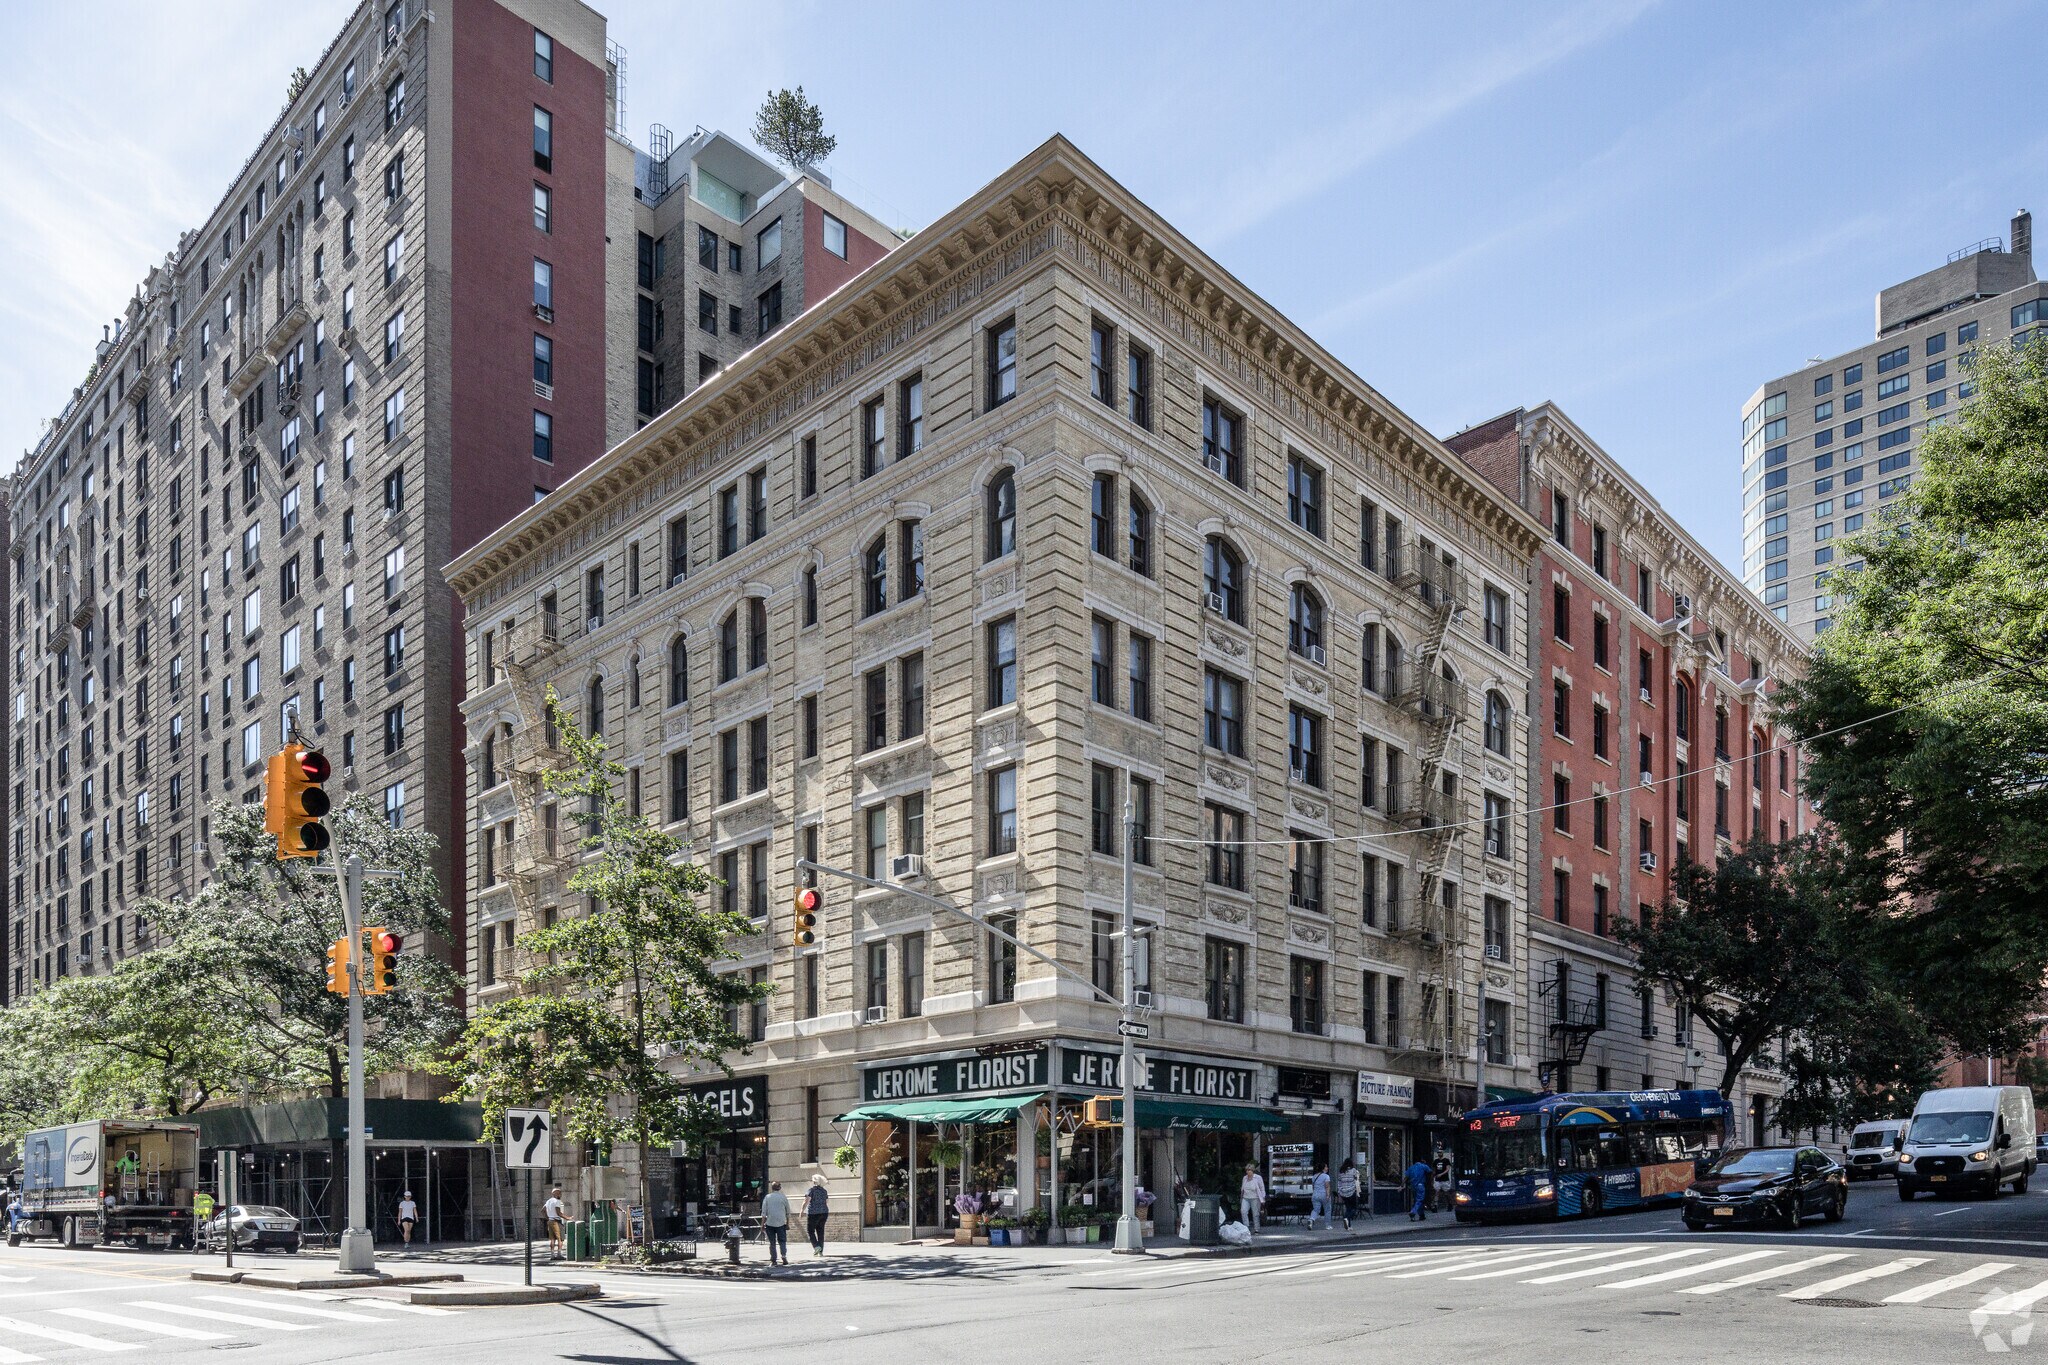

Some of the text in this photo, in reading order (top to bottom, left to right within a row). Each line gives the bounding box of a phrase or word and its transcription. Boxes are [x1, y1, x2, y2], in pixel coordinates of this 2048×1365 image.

[873, 1053, 1038, 1098] JEROME FLORIST
[1072, 1054, 1247, 1098] JERE FLORIST
[1361, 1082, 1412, 1098] PICTURE FRAMING
[1670, 1091, 1681, 1101] bus
